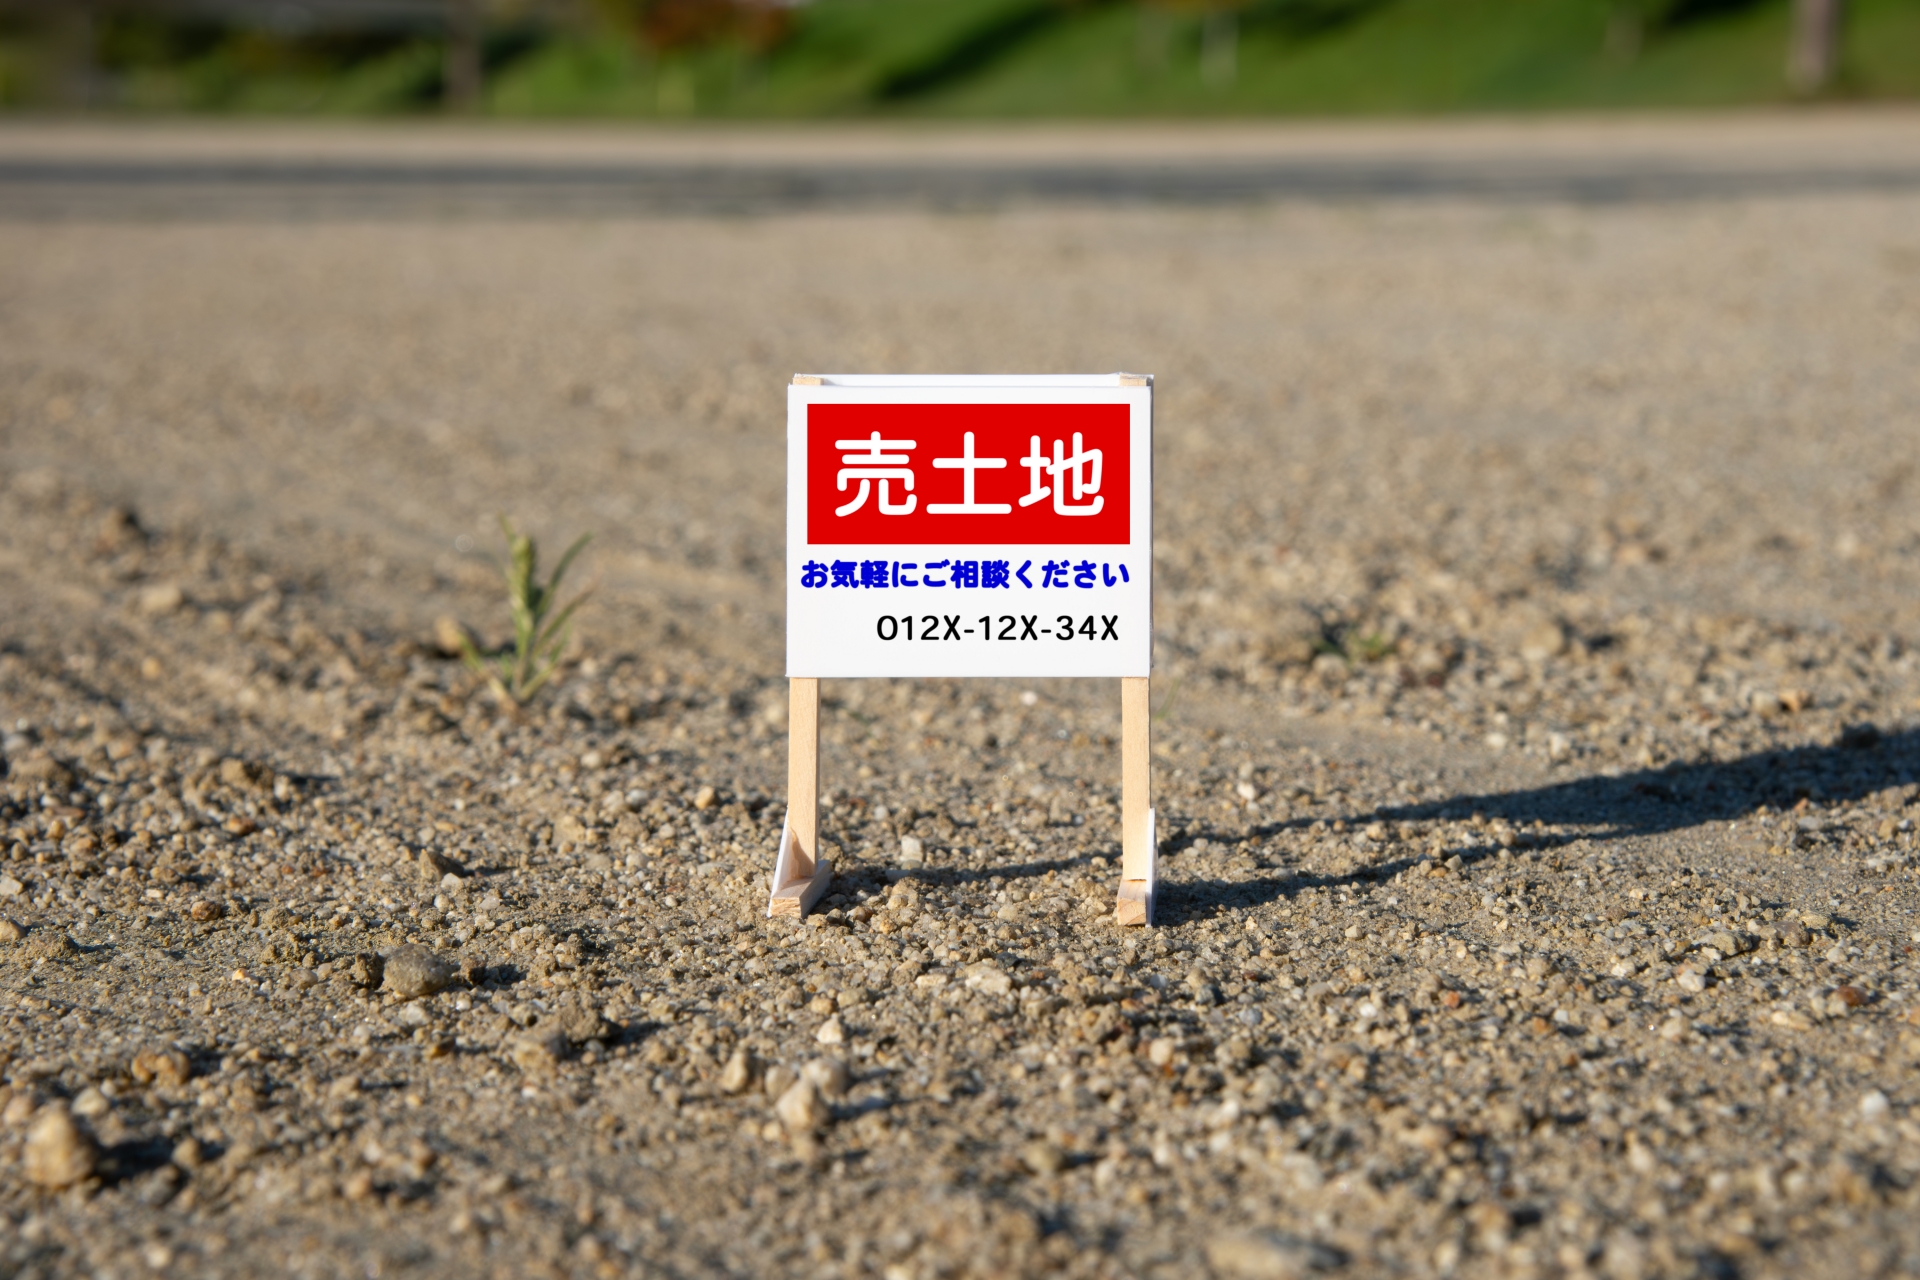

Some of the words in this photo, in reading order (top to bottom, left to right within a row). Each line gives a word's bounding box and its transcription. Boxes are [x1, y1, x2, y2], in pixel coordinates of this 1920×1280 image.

[834, 430, 1105, 517] 売土地
[800, 558, 1130, 590] お気軽にご相談ください
[876, 614, 1119, 641] 012X-12X-34X
